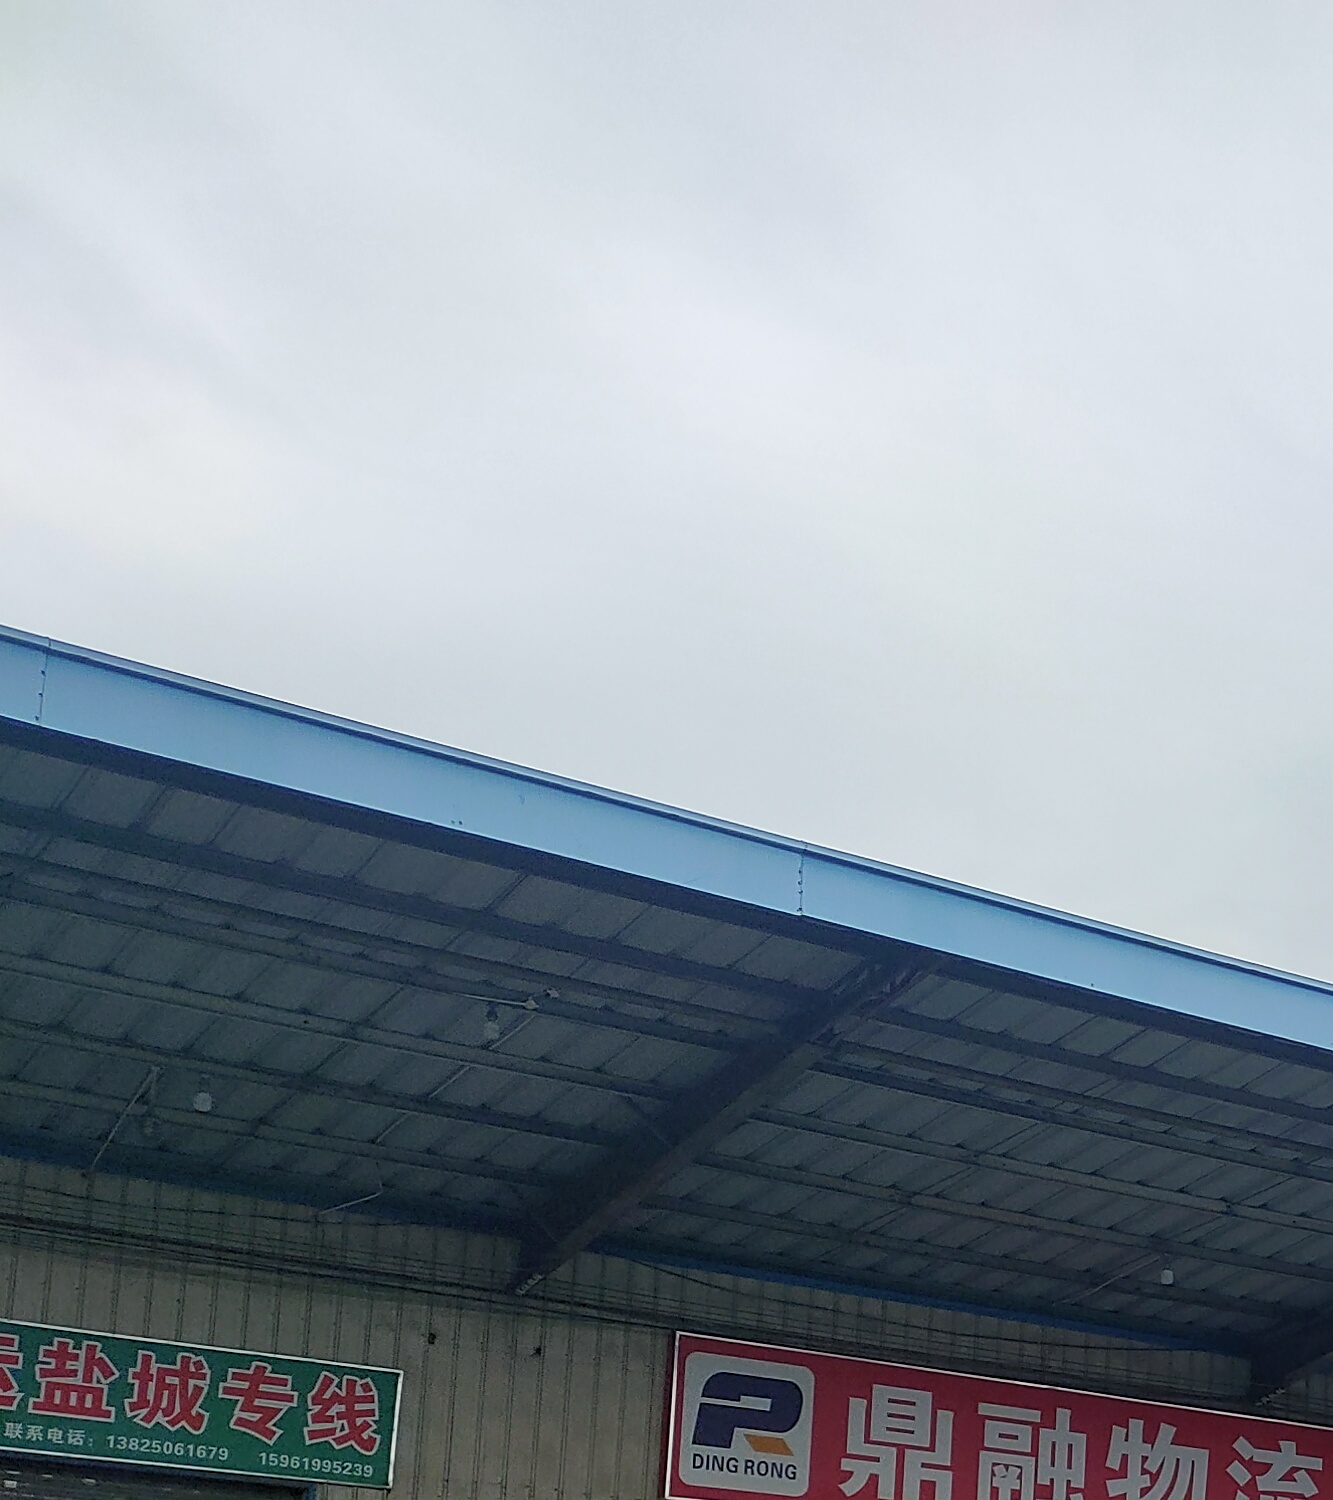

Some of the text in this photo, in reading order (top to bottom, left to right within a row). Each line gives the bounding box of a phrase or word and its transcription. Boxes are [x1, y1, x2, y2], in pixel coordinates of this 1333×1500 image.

[106, 1434, 229, 1461] 13825061679
[258, 1452, 374, 1478] 15961995239
[692, 1452, 798, 1480] DING RONG
